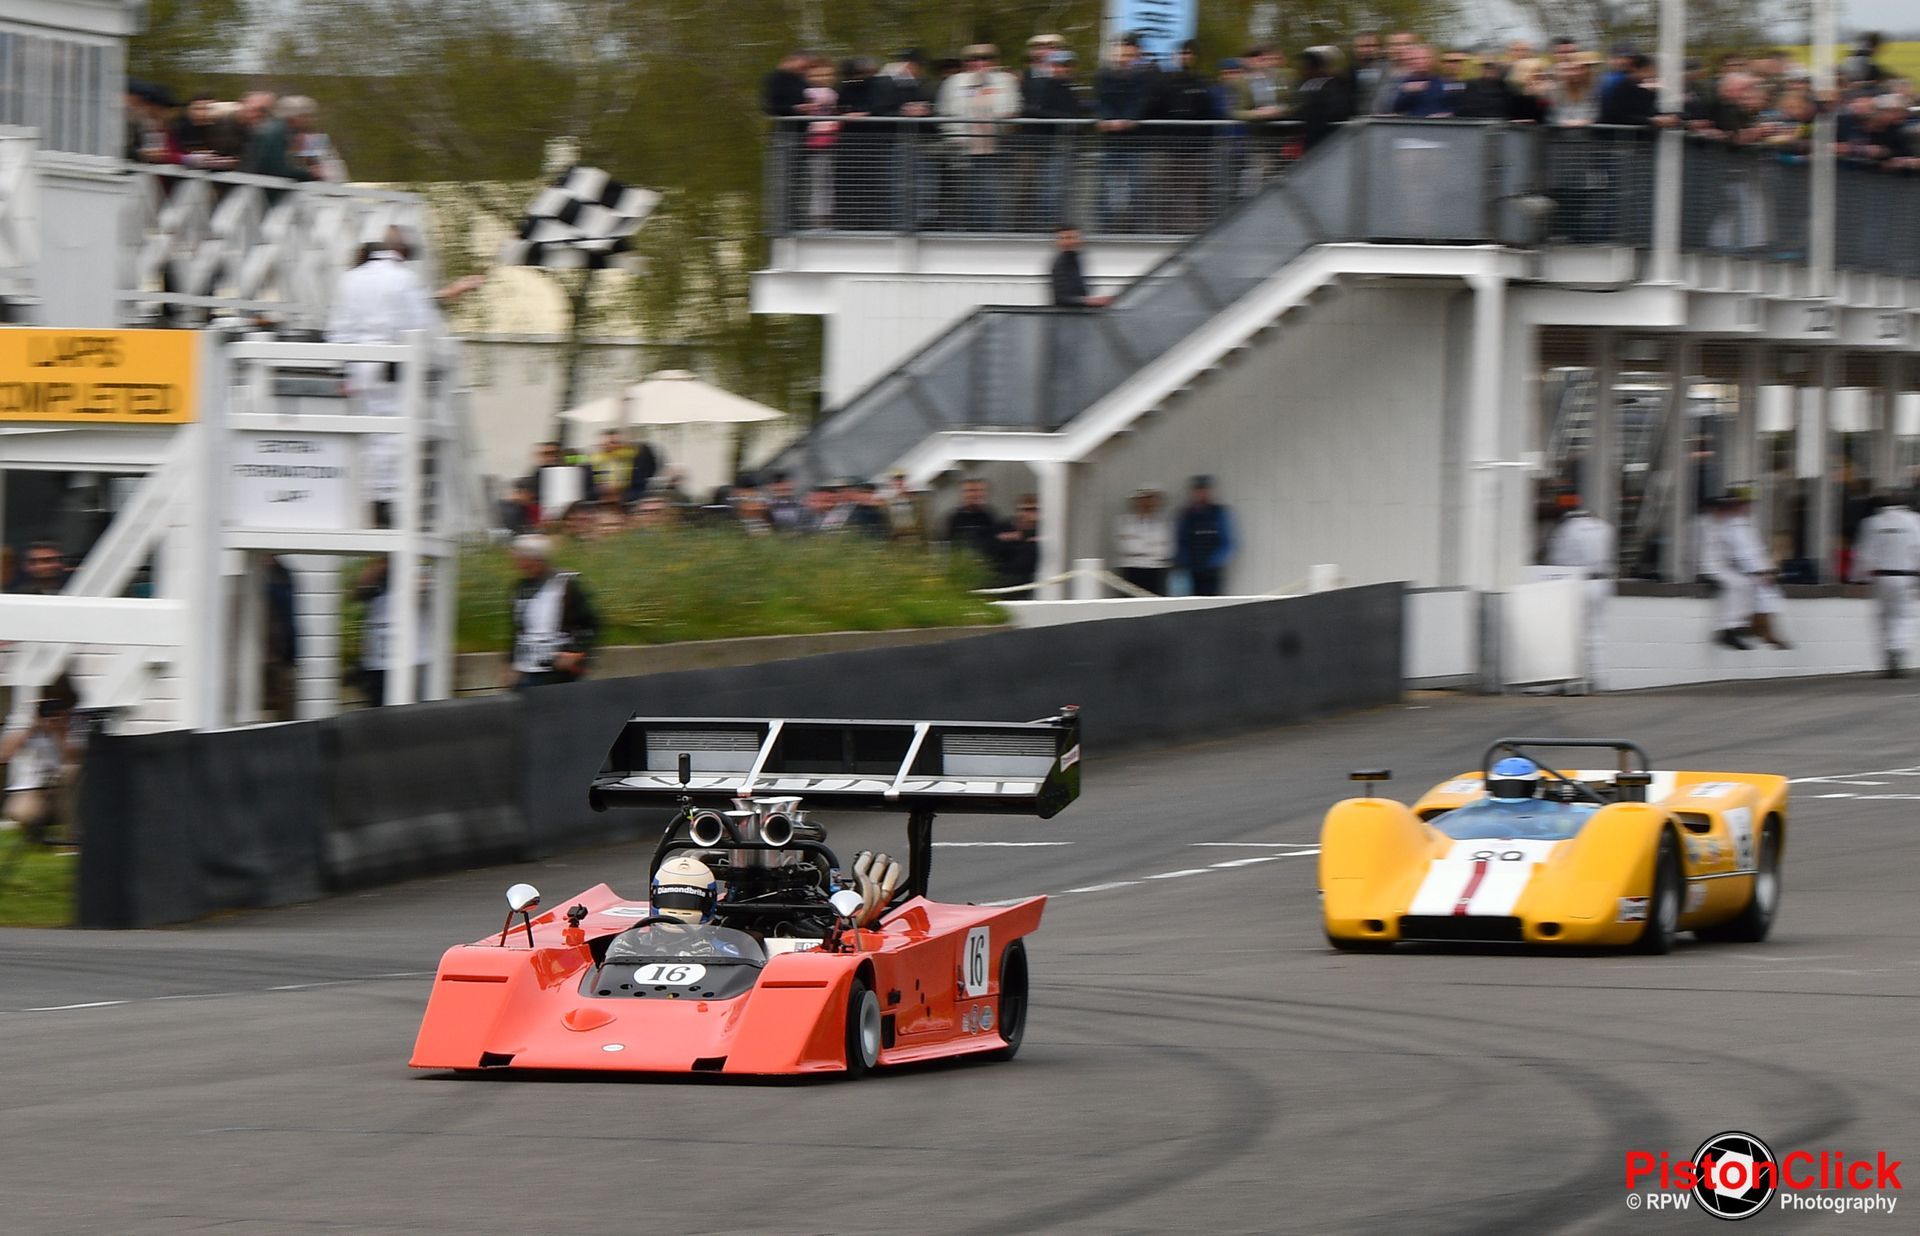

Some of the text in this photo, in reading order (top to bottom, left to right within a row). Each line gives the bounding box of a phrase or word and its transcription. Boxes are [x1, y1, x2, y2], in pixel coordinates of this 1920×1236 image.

[28, 336, 123, 367] LAPS
[0, 381, 181, 414] OMPLETED
[657, 886, 706, 898] Diamondbrite
[648, 965, 692, 982] 16
[969, 934, 985, 987] 16
